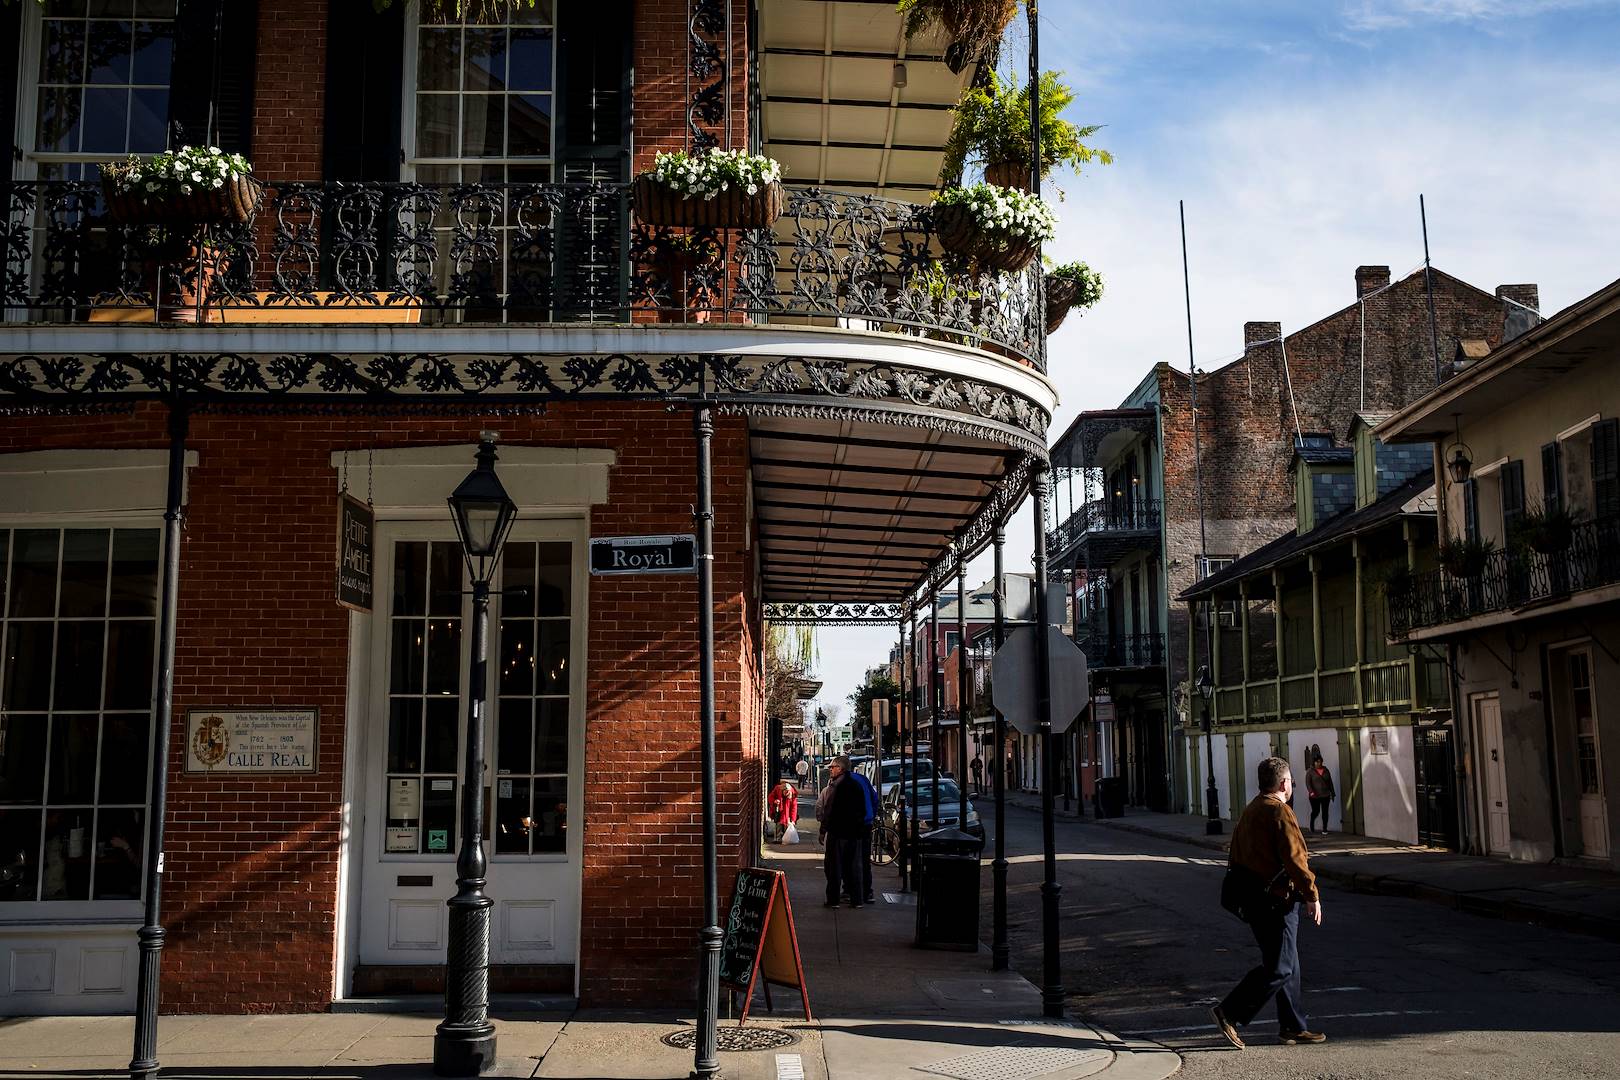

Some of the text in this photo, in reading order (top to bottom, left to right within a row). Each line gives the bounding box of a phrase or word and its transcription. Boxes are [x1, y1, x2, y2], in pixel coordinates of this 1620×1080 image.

[612, 548, 673, 568] Royal
[229, 752, 310, 766] CALLE REAL
